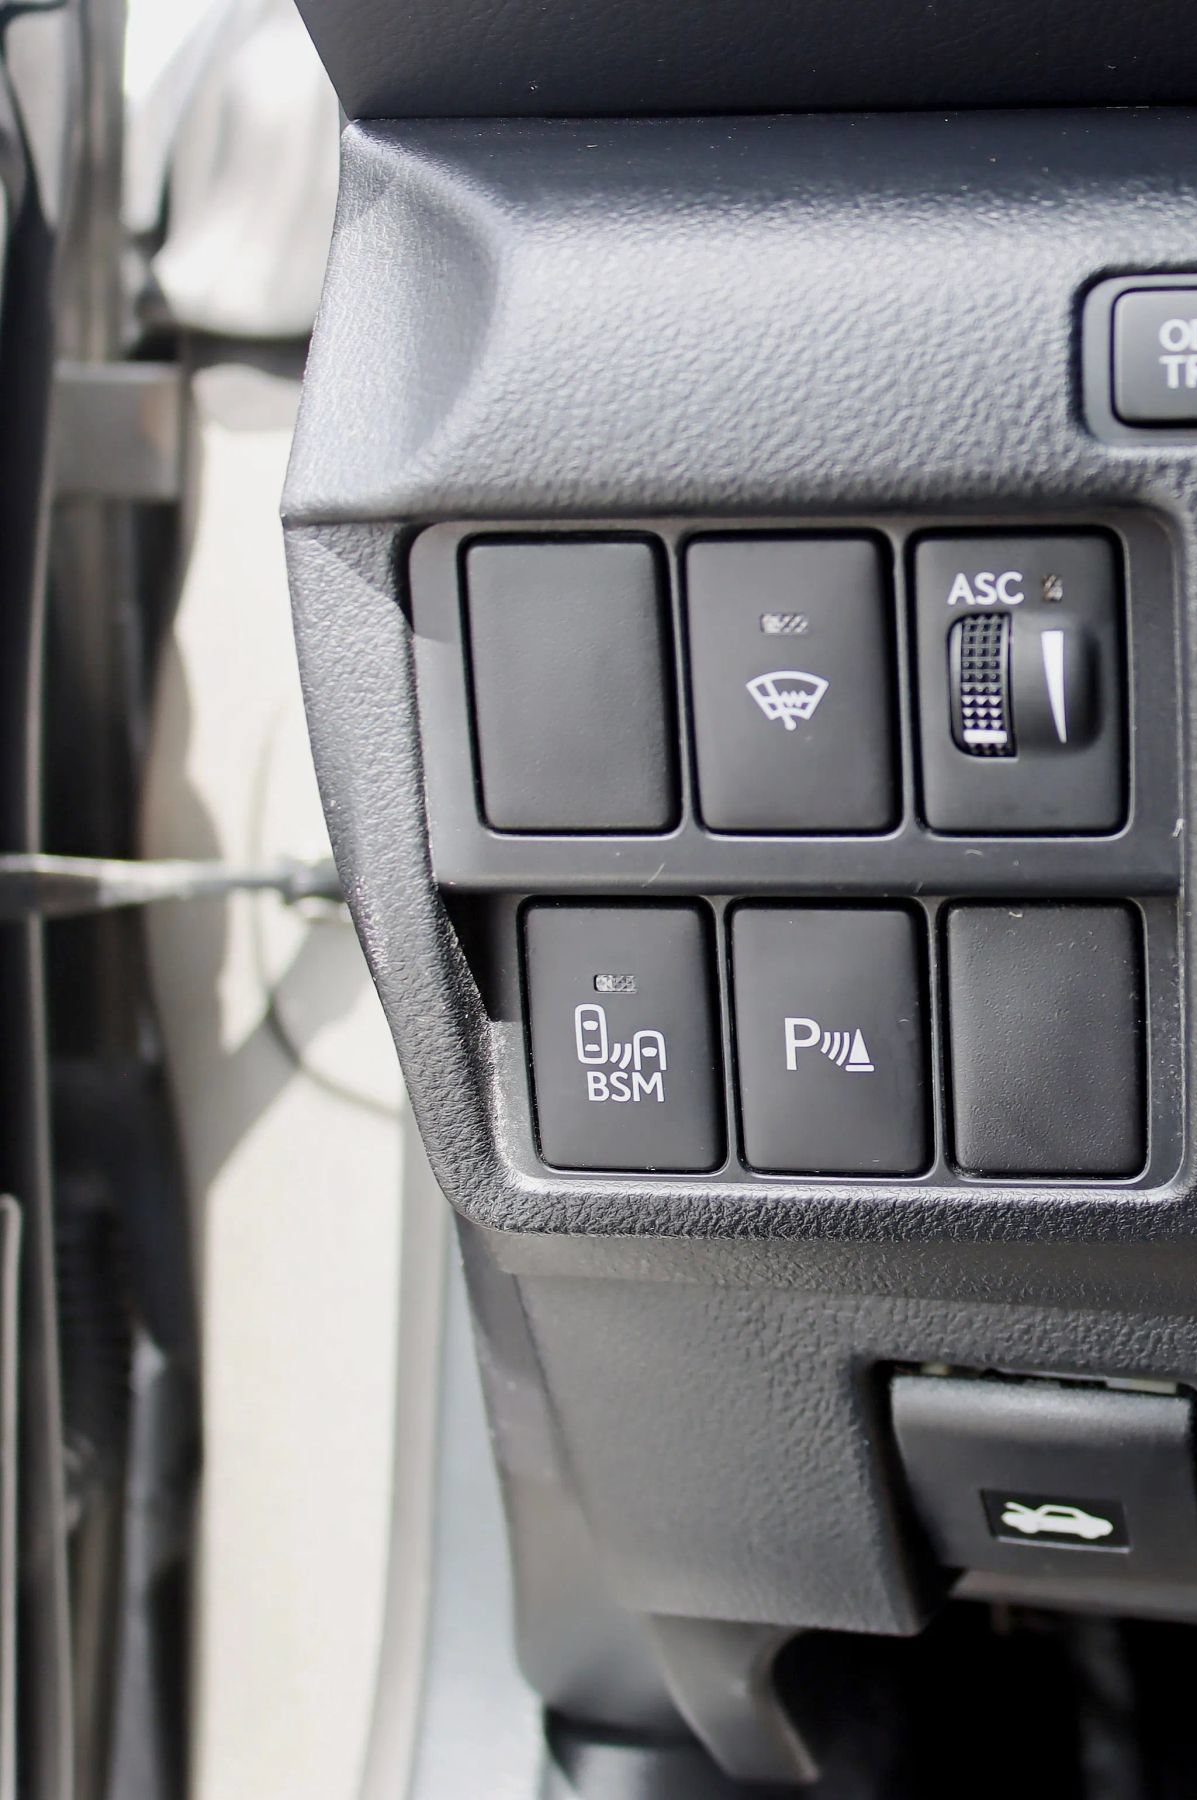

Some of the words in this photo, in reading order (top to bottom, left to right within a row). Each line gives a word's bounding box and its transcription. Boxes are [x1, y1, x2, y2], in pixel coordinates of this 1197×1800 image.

[947, 572, 1025, 605] ASC
[785, 1017, 820, 1071] P
[586, 1071, 665, 1102] BSM
